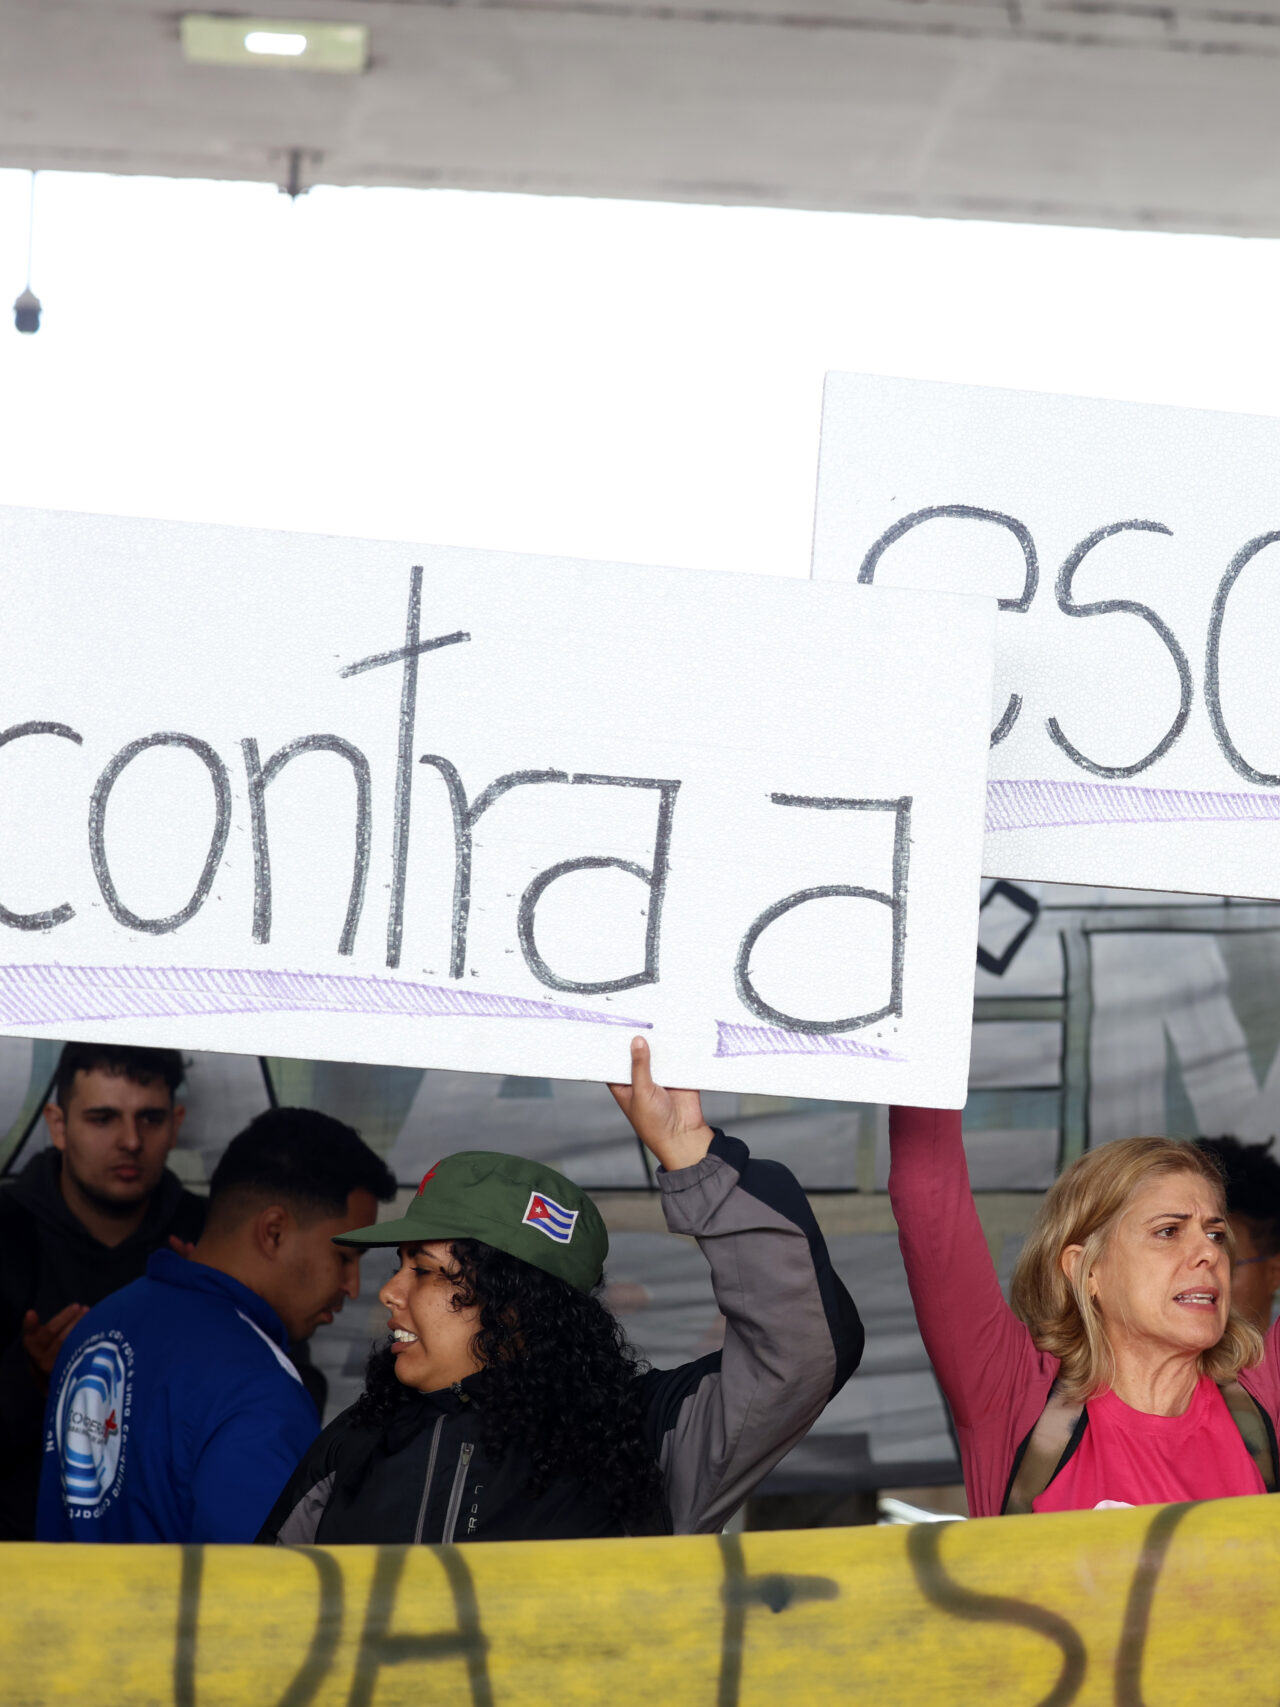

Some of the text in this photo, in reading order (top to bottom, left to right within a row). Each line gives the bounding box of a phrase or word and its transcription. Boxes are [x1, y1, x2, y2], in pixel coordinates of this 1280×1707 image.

[0, 566, 913, 1035] contra a
[123, 1382, 133, 1417] uma
